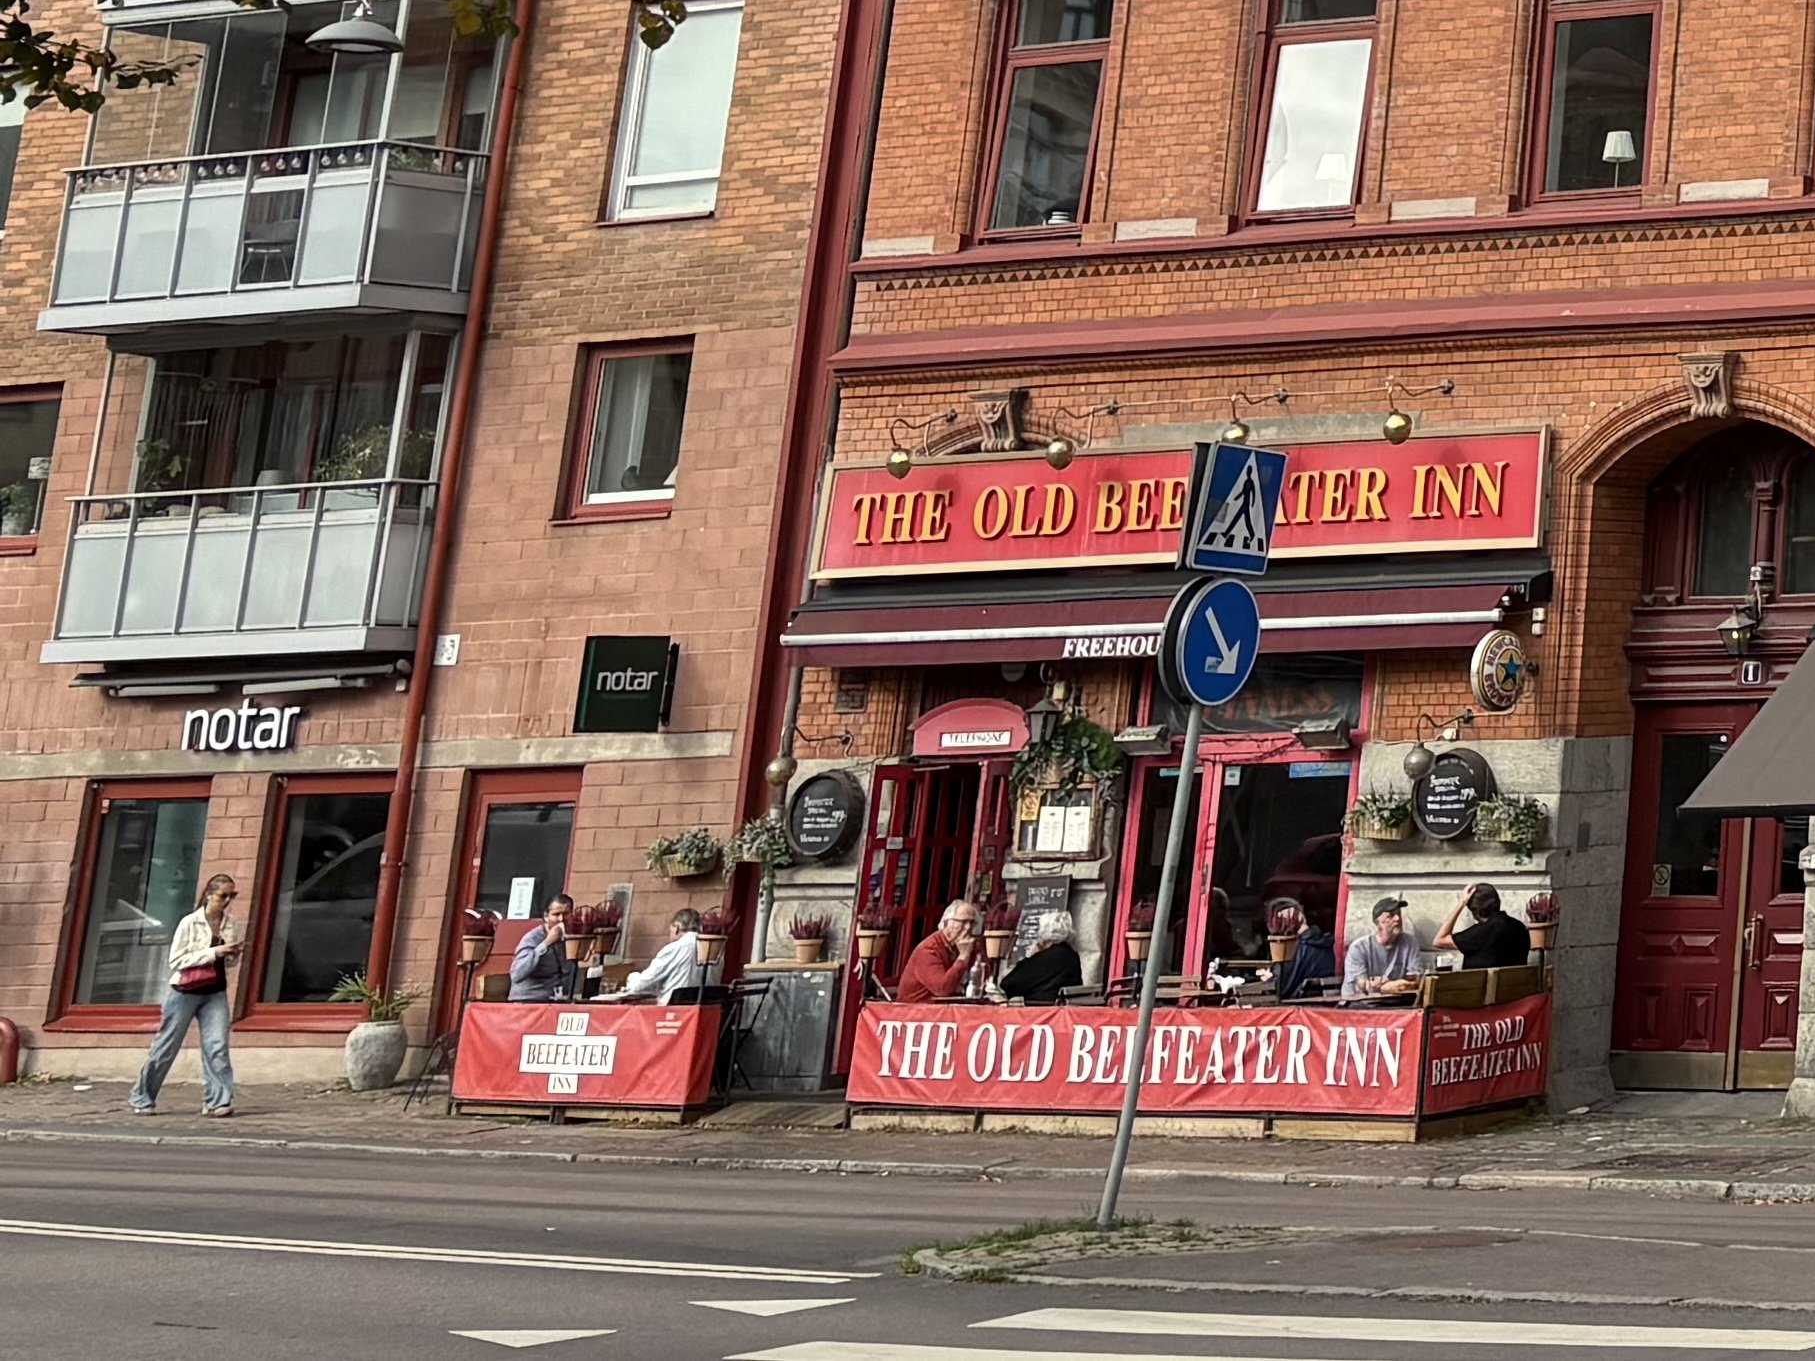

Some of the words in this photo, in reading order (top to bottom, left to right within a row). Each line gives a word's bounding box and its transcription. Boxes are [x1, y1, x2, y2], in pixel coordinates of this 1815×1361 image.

[853, 490, 952, 545] THE
[973, 483, 1075, 540] OLD
[1092, 467, 1389, 534] BEETER
[1409, 460, 1509, 518] INN
[1062, 635, 1162, 659] FREEHOU
[596, 669, 659, 692] notar
[181, 698, 301, 751] notar
[560, 1015, 584, 1032] OLD
[1462, 1023, 1492, 1050] THE
[1495, 1015, 1525, 1045] OLD
[527, 1043, 609, 1066] BEEFEATER
[877, 1020, 958, 1080] THE
[967, 1022, 1056, 1082] OLD
[1323, 1026, 1405, 1089] INN
[1431, 1048, 1514, 1086] BEEFEATER
[1515, 1042, 1542, 1072] INN
